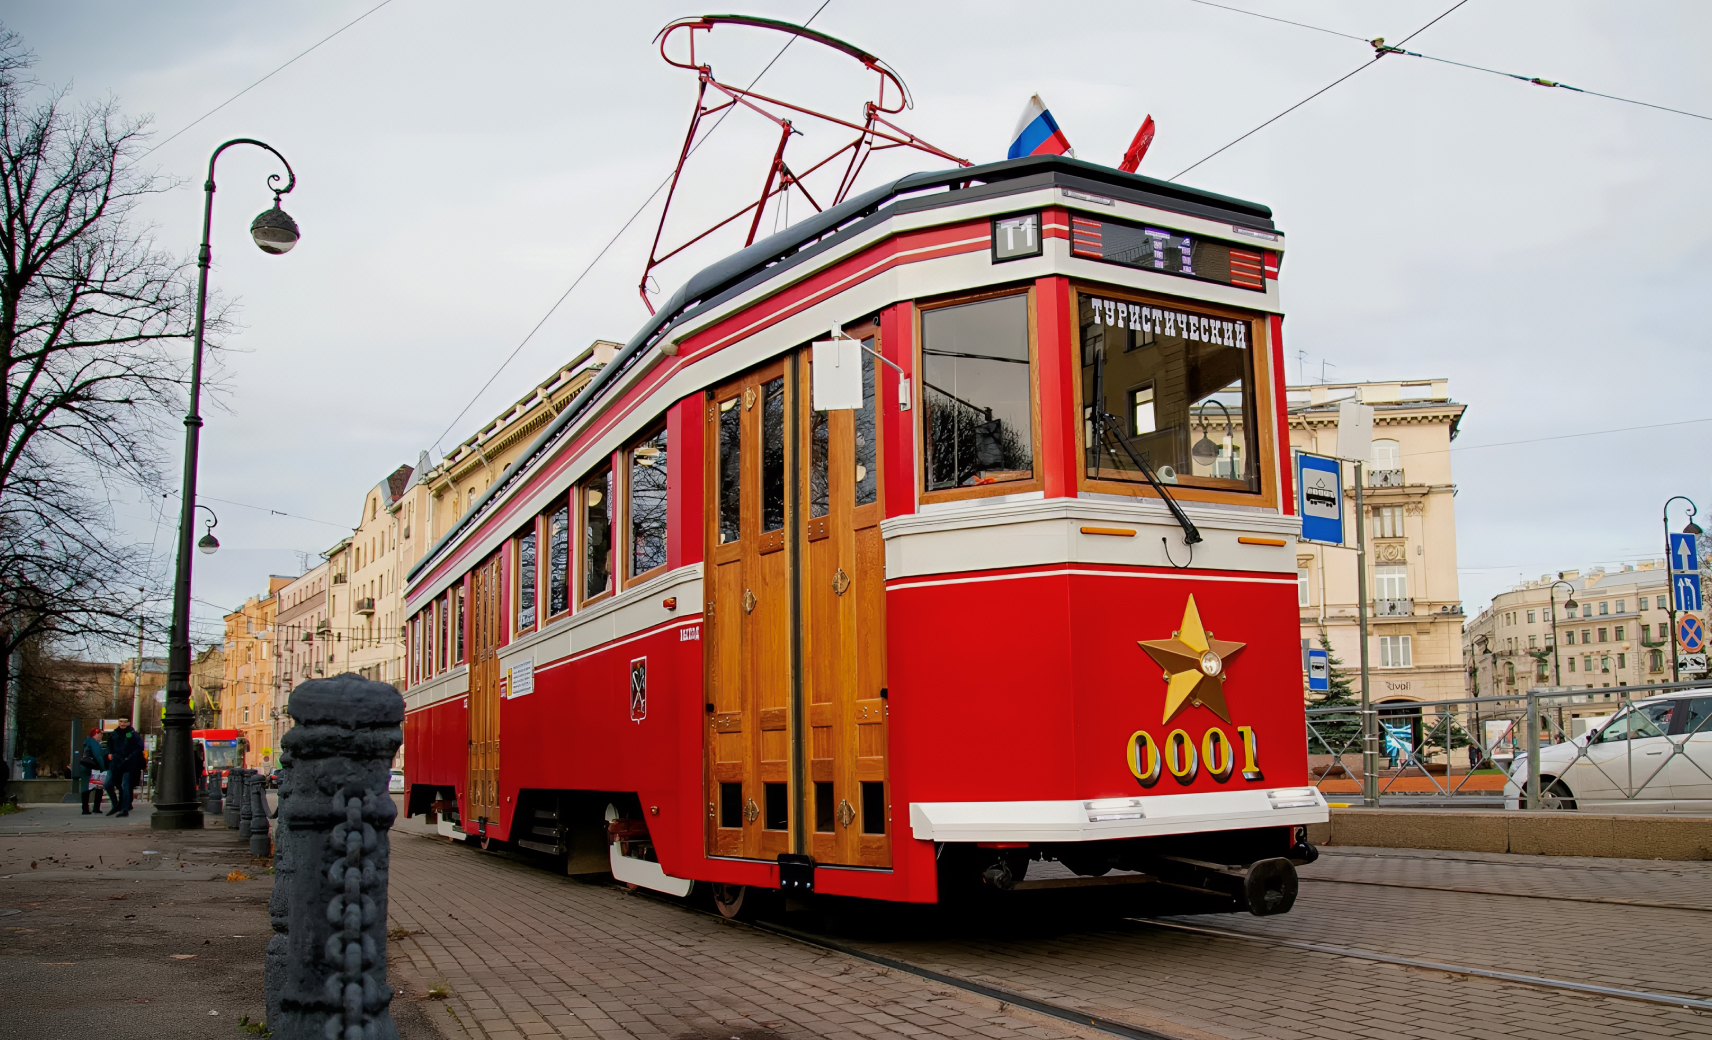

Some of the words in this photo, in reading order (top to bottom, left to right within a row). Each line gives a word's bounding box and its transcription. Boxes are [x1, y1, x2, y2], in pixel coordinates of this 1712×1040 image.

[1000, 217, 1033, 251] Т1
[1091, 297, 1248, 350] ТУРИСТИЧЕСКИЙ
[1126, 726, 1262, 784] 0001
